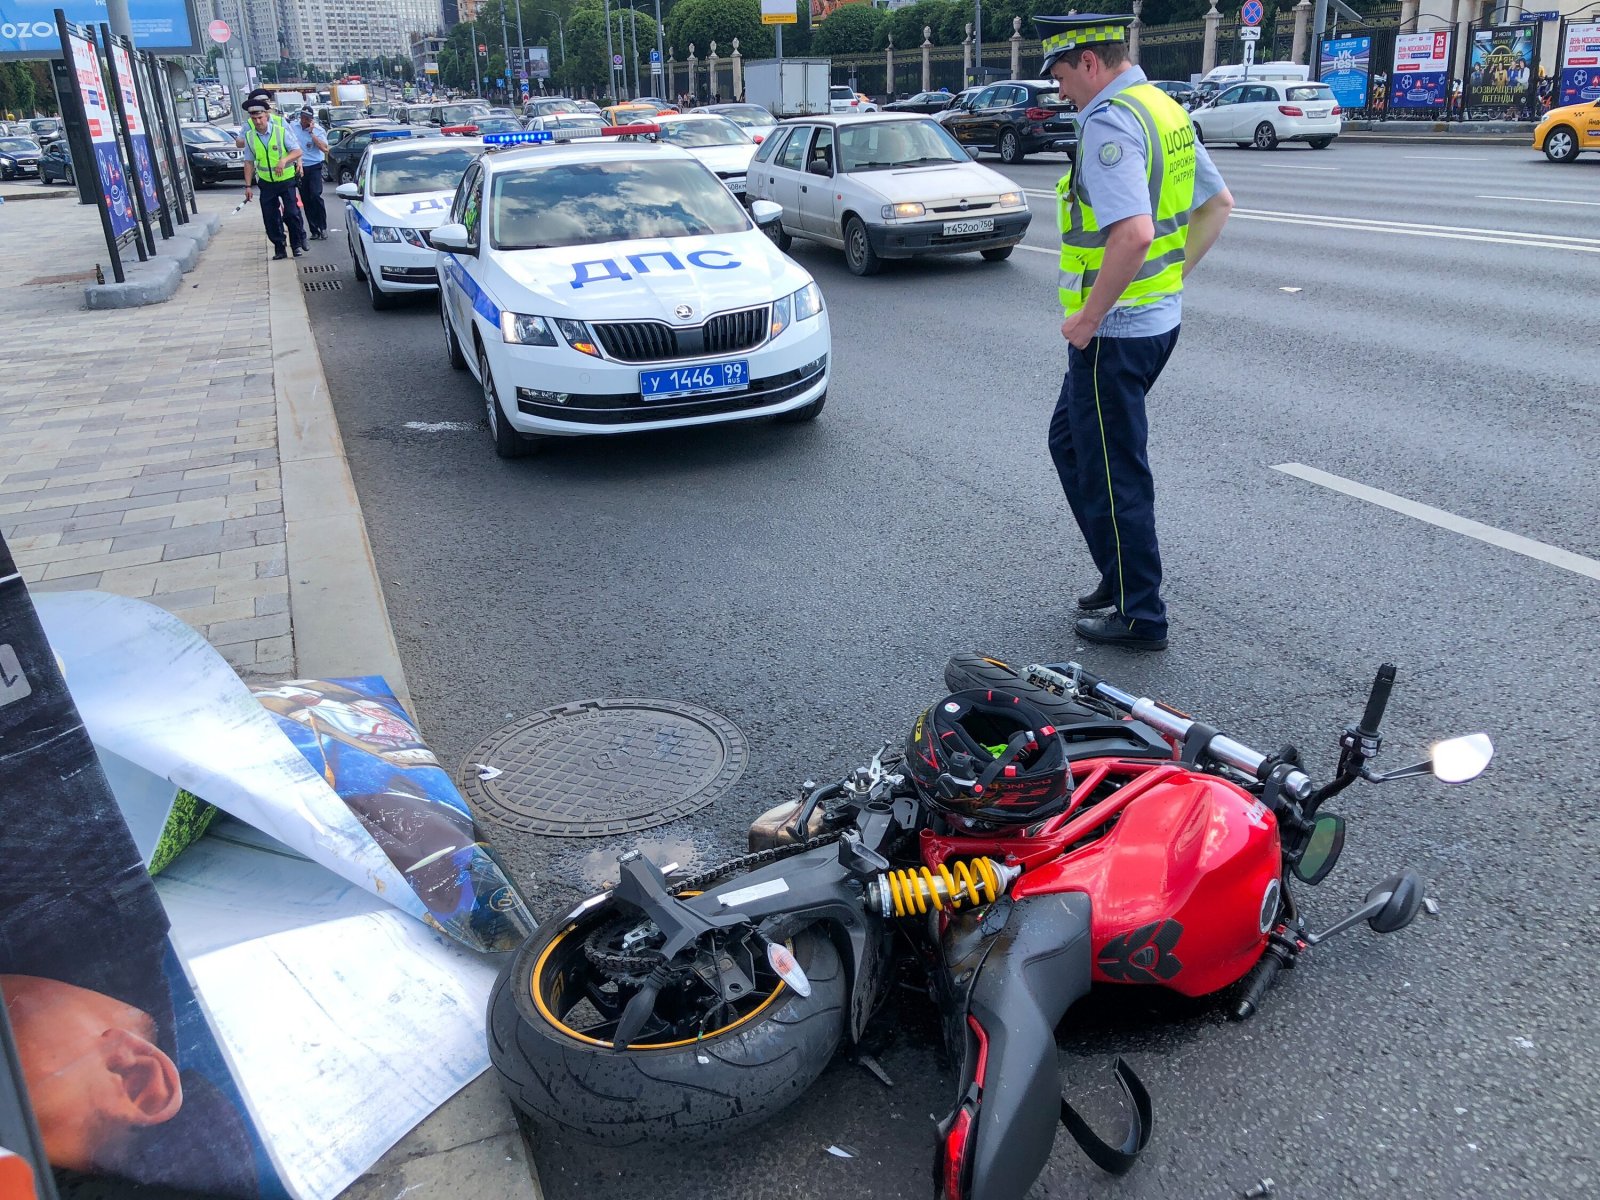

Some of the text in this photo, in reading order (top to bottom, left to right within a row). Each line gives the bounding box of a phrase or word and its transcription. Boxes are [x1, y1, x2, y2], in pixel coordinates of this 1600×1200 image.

[1, 21, 59, 38] OZO
[1436, 35, 1445, 46] 25
[1338, 50, 1352, 58] VK
[1333, 56, 1357, 69] fest
[1481, 95, 1514, 104] ЛЕГЕНДЫ
[980, 220, 992, 228] 750
[569, 250, 742, 289] ДПС
[669, 367, 714, 389] 1446
[724, 363, 742, 378] 99
